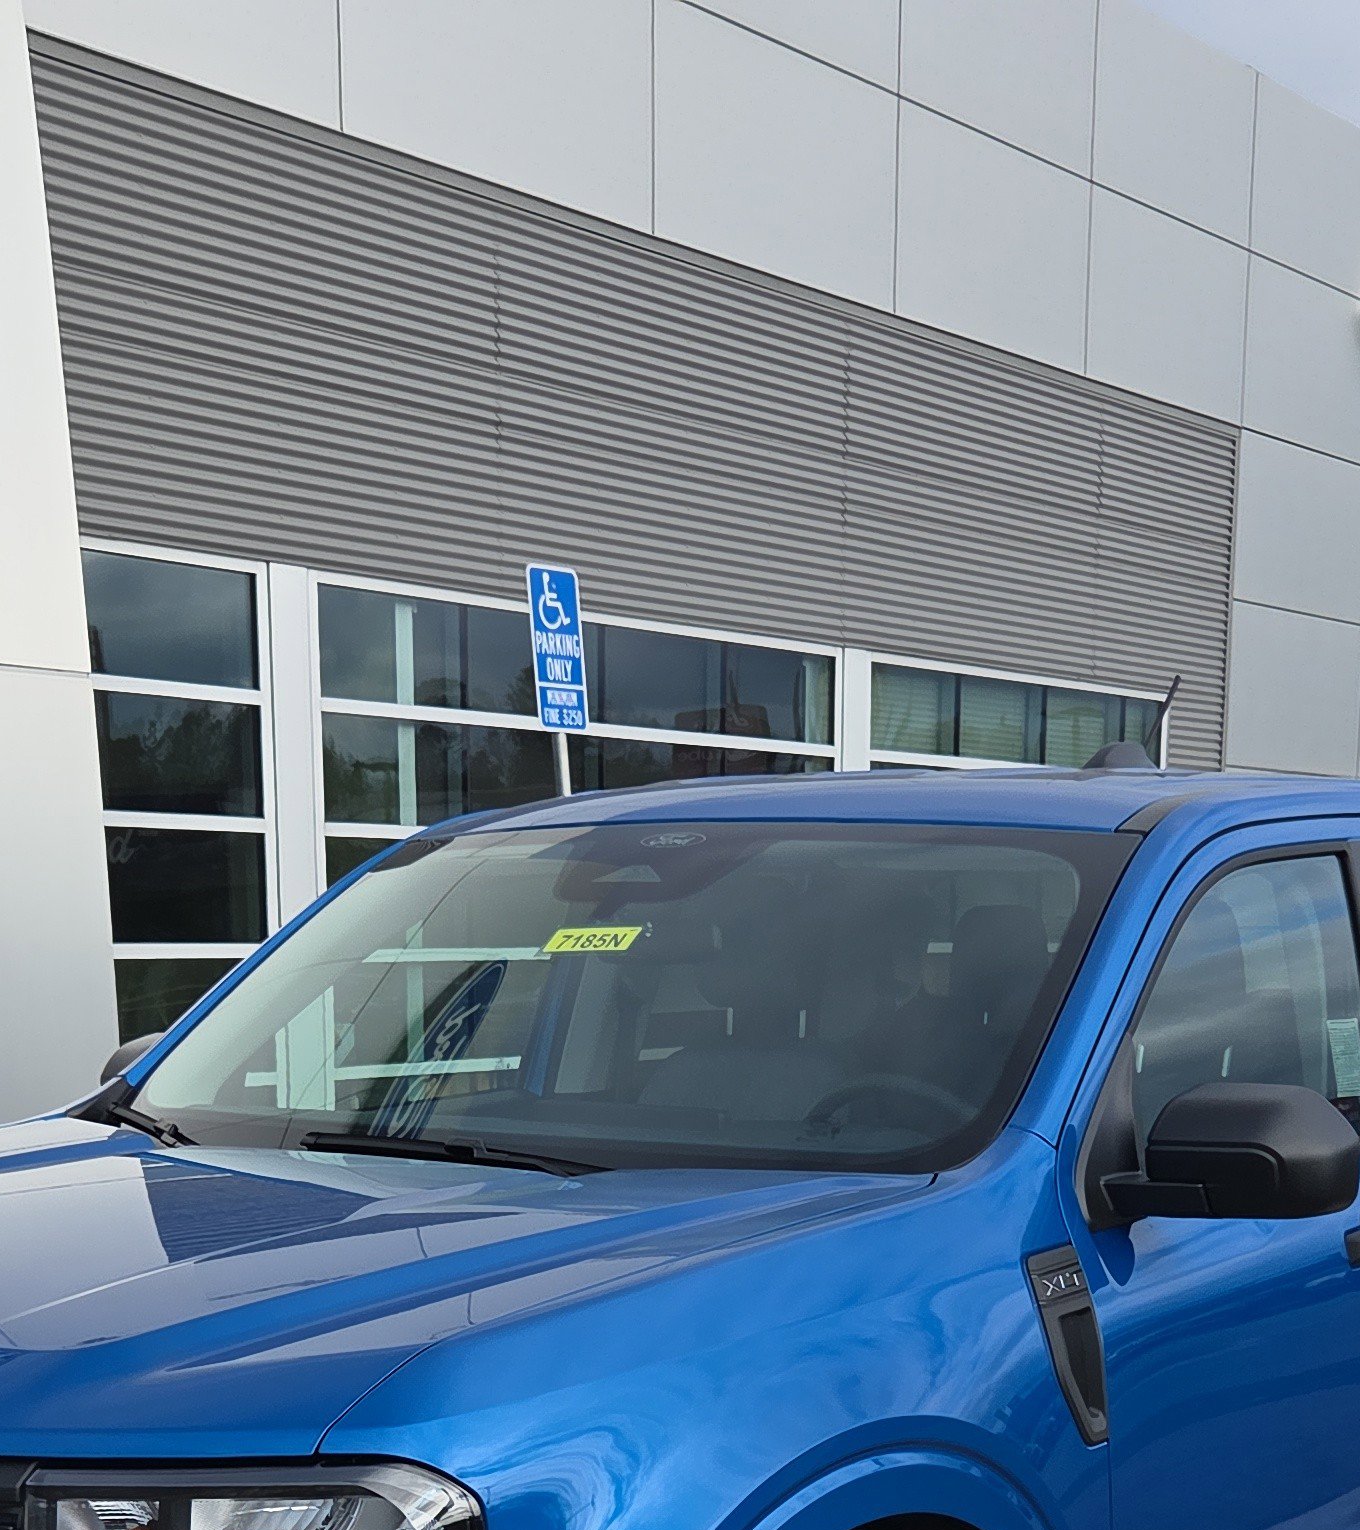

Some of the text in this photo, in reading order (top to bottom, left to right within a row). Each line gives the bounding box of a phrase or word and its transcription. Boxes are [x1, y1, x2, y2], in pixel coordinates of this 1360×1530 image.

[535, 630, 581, 659] PARKING
[546, 657, 573, 682] ONLY
[543, 707, 561, 725] FINE
[555, 932, 628, 950] 7185N
